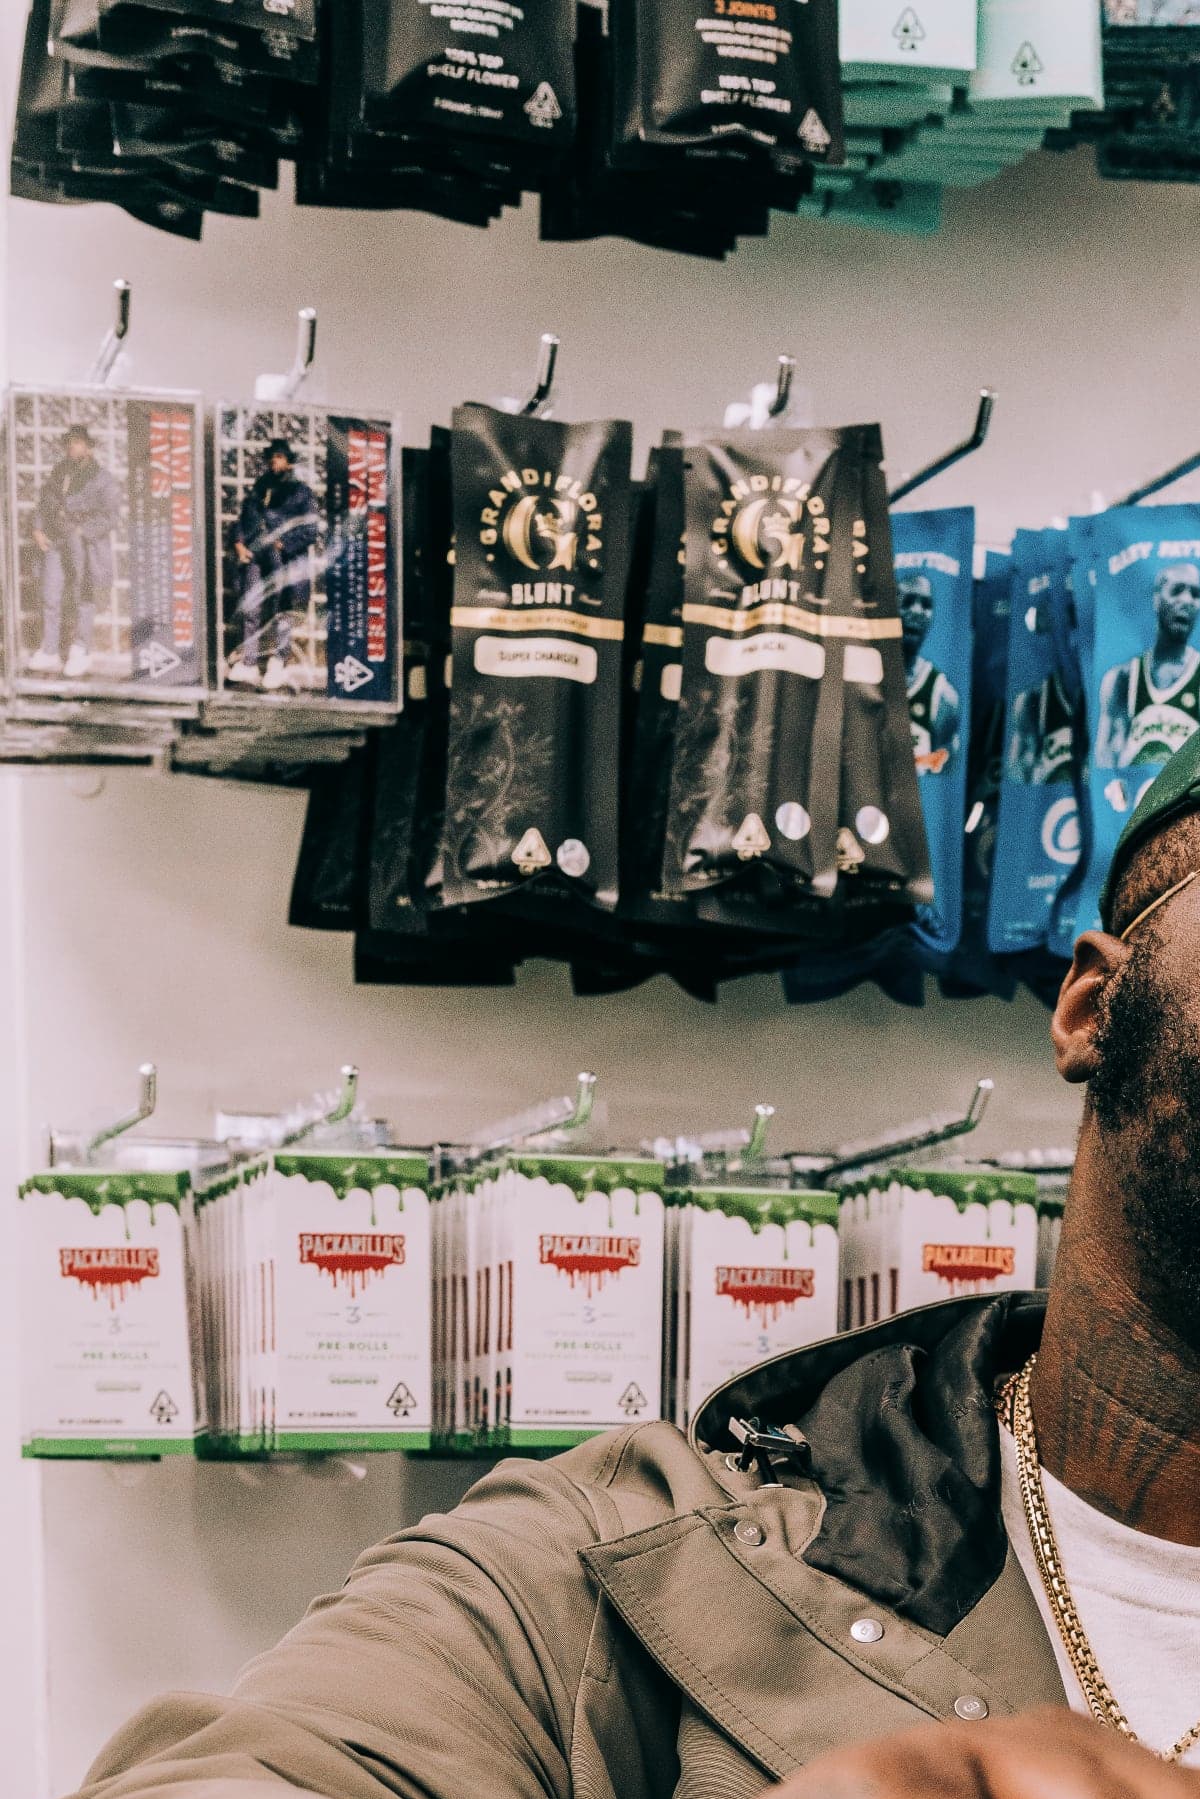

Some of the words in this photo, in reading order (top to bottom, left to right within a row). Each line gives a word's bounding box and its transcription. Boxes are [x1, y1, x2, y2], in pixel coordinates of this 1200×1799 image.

[477, 53, 504, 70] TOP
[466, 68, 520, 90] FLOWER
[170, 411, 192, 491] JAM
[366, 430, 387, 507] JAM
[480, 467, 604, 554] GRANDIFLORA
[711, 474, 831, 556] GRANDIFLORA
[171, 493, 194, 649] MASTER
[366, 511, 388, 662] MASTER
[511, 582, 575, 606] BLUNT
[740, 577, 800, 607] BLUNT
[59, 1247, 160, 1277] PACKARILLOS
[299, 1233, 406, 1264] PACKARILLOS
[539, 1233, 641, 1267] PACKARILLOS
[923, 1243, 1015, 1275] PACKARILLOS
[715, 1266, 815, 1298] PACKARILLOS
[345, 1305, 362, 1325] 3
[318, 1341, 390, 1351] PRE-ROLLS
[554, 1341, 624, 1351] PRE-ROLLS
[757, 1335, 770, 1354] 3
[392, 1409, 411, 1418] CA
